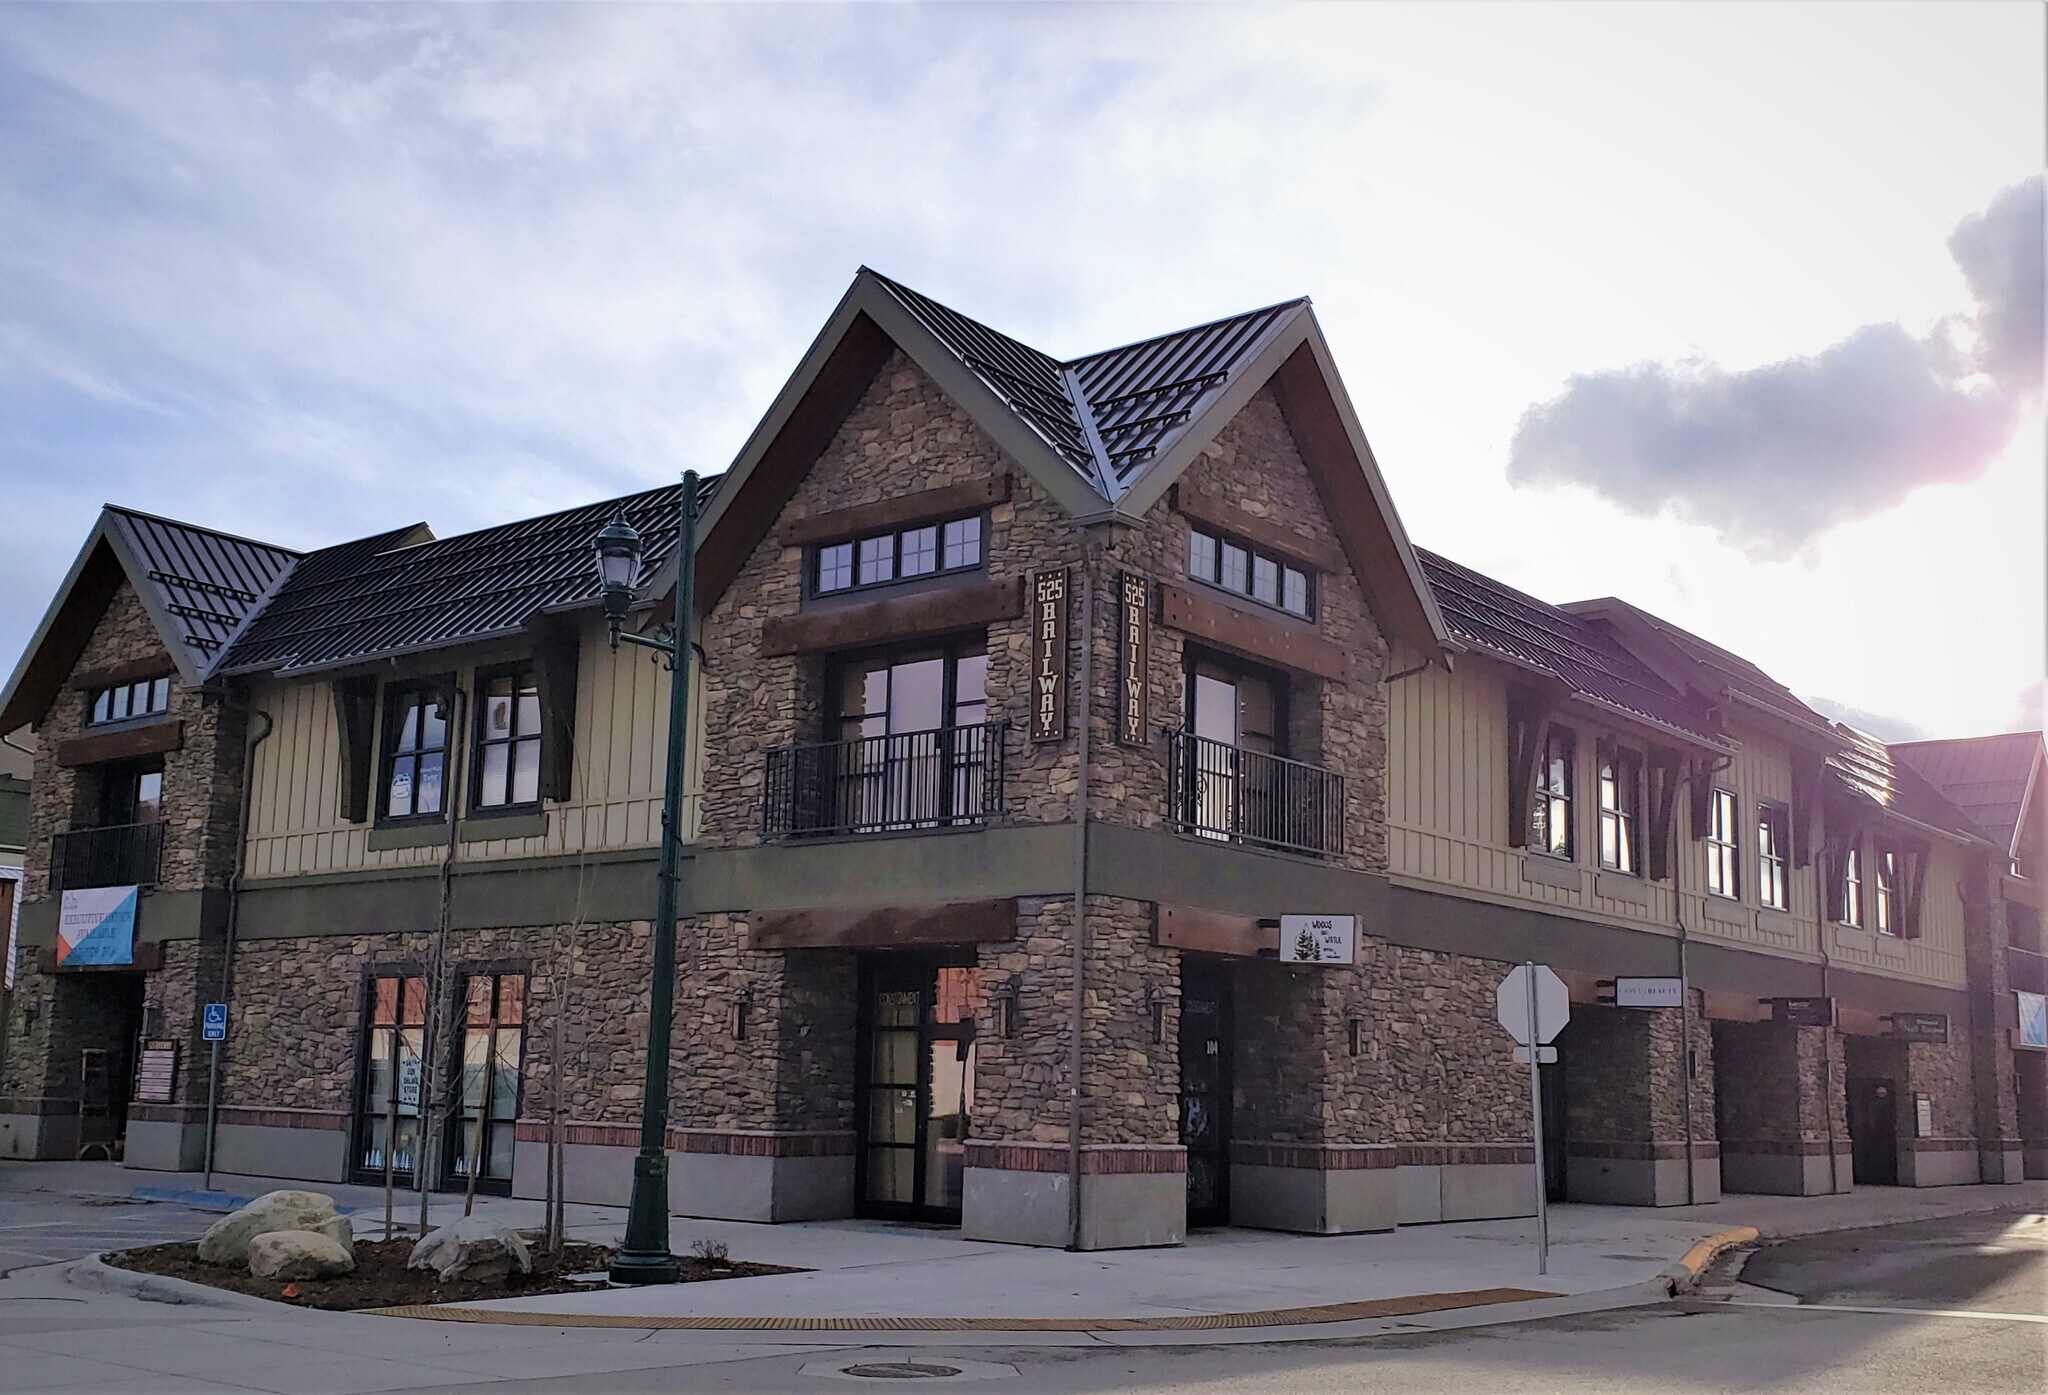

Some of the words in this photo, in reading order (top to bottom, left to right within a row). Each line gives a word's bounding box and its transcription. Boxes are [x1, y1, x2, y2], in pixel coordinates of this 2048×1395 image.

[1037, 579, 1063, 602] 525
[1125, 583, 1145, 607] 525
[1038, 602, 1059, 731] RAILWAY
[1125, 606, 1142, 735] RAILWAY
[65, 912, 104, 925] EXECUTIVE
